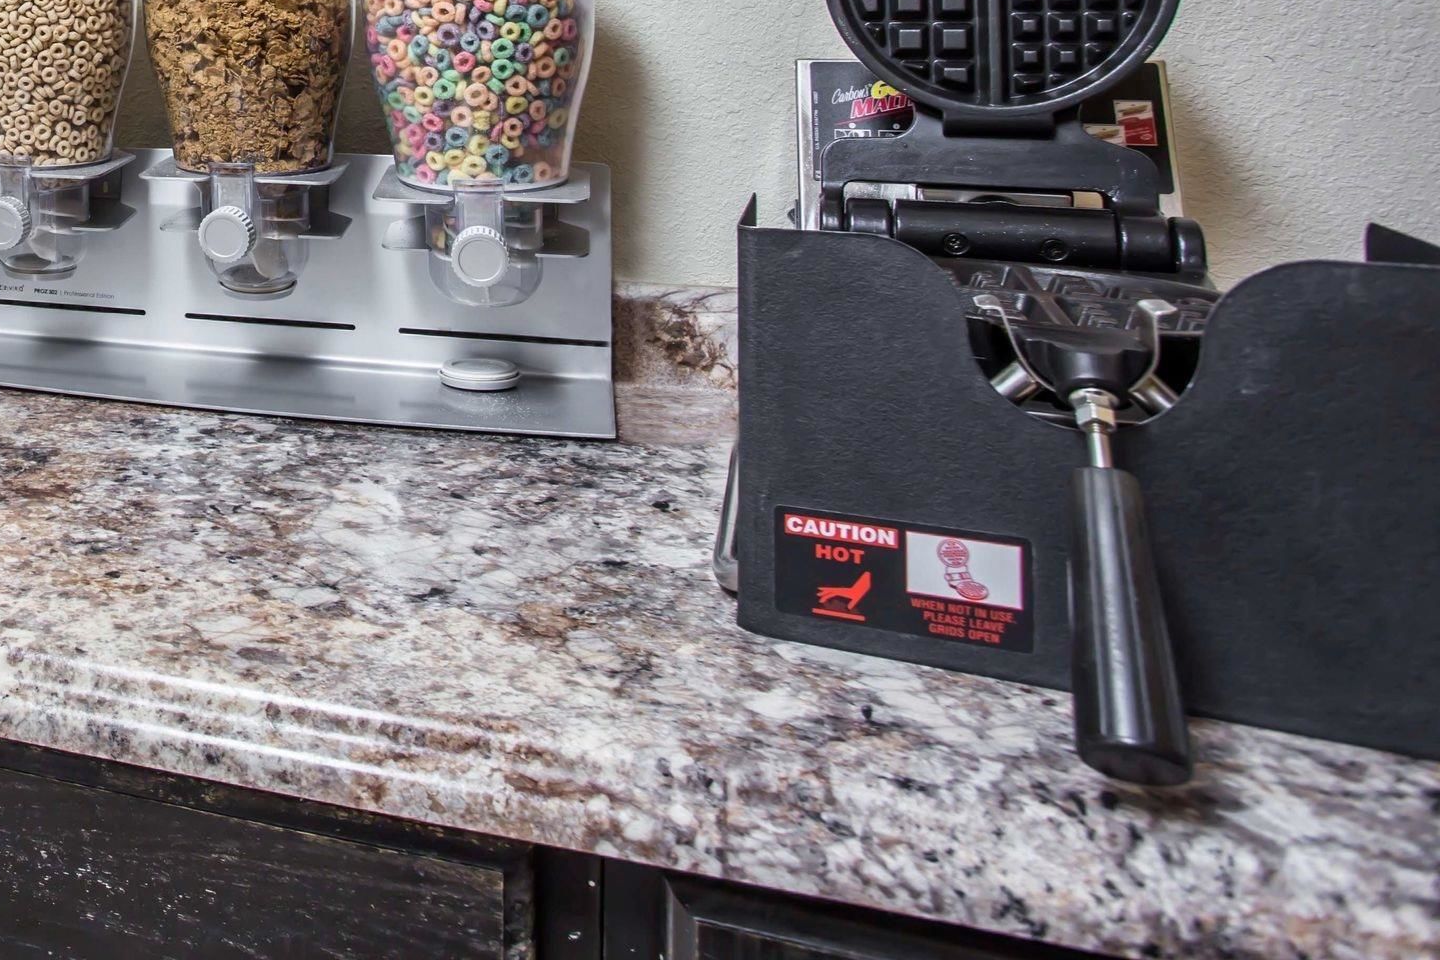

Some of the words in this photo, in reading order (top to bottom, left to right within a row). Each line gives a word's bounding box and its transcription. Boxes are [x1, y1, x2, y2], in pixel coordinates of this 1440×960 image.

[785, 515, 896, 546] CAUTION
[815, 544, 865, 564] HOT
[911, 597, 945, 611] WHEN
[947, 603, 971, 615] NOT
[974, 607, 987, 618] IN
[923, 610, 966, 626] PLEASE
[969, 618, 1005, 633] LEAVE
[928, 623, 965, 638] GRIDS
[968, 629, 1001, 643] OPEN
